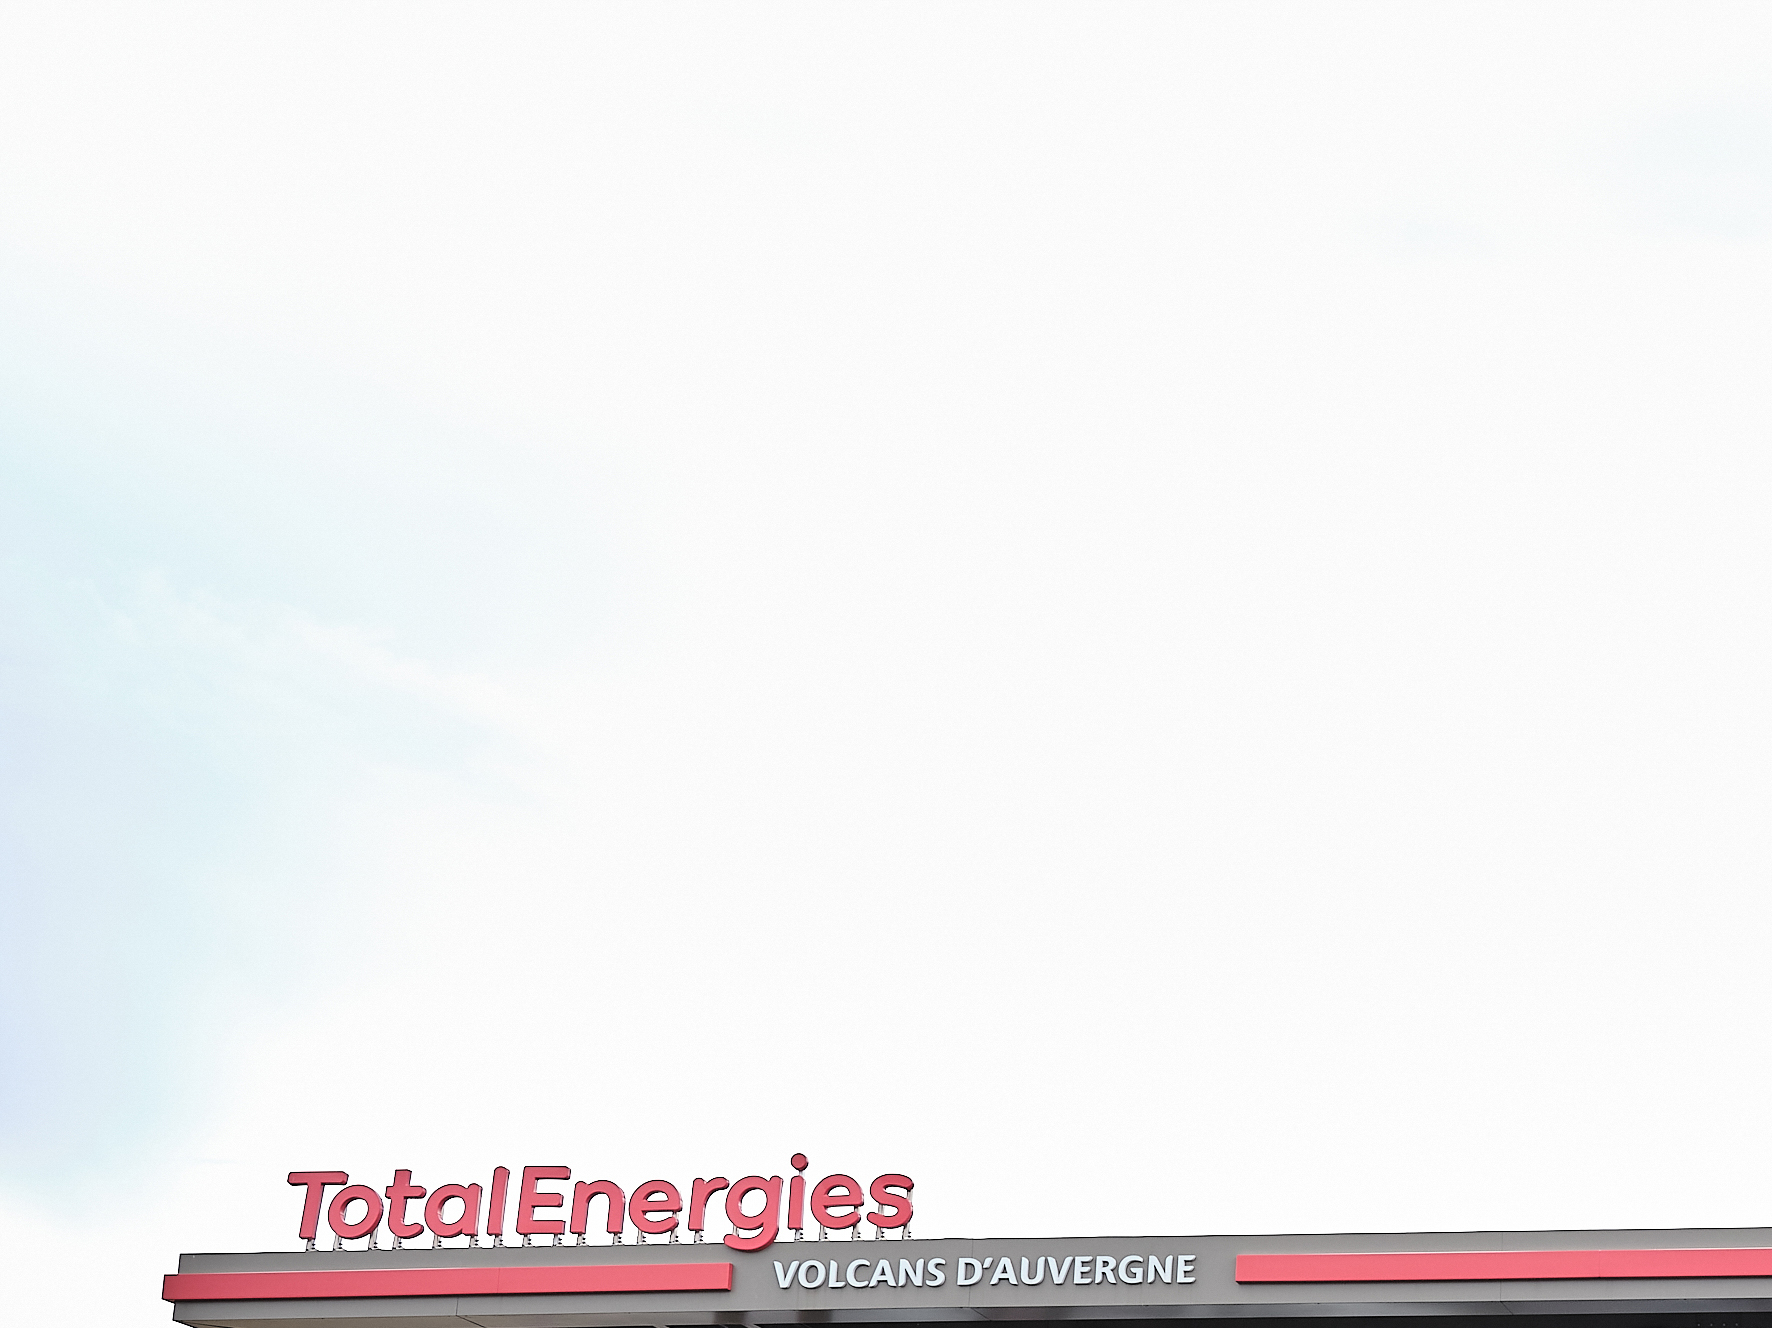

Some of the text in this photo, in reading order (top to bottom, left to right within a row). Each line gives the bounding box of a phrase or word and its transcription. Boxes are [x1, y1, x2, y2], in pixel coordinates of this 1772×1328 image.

[287, 1152, 914, 1251] TotalEnergies
[773, 1254, 1197, 1289] VOLCANS D'AUVERGNE
